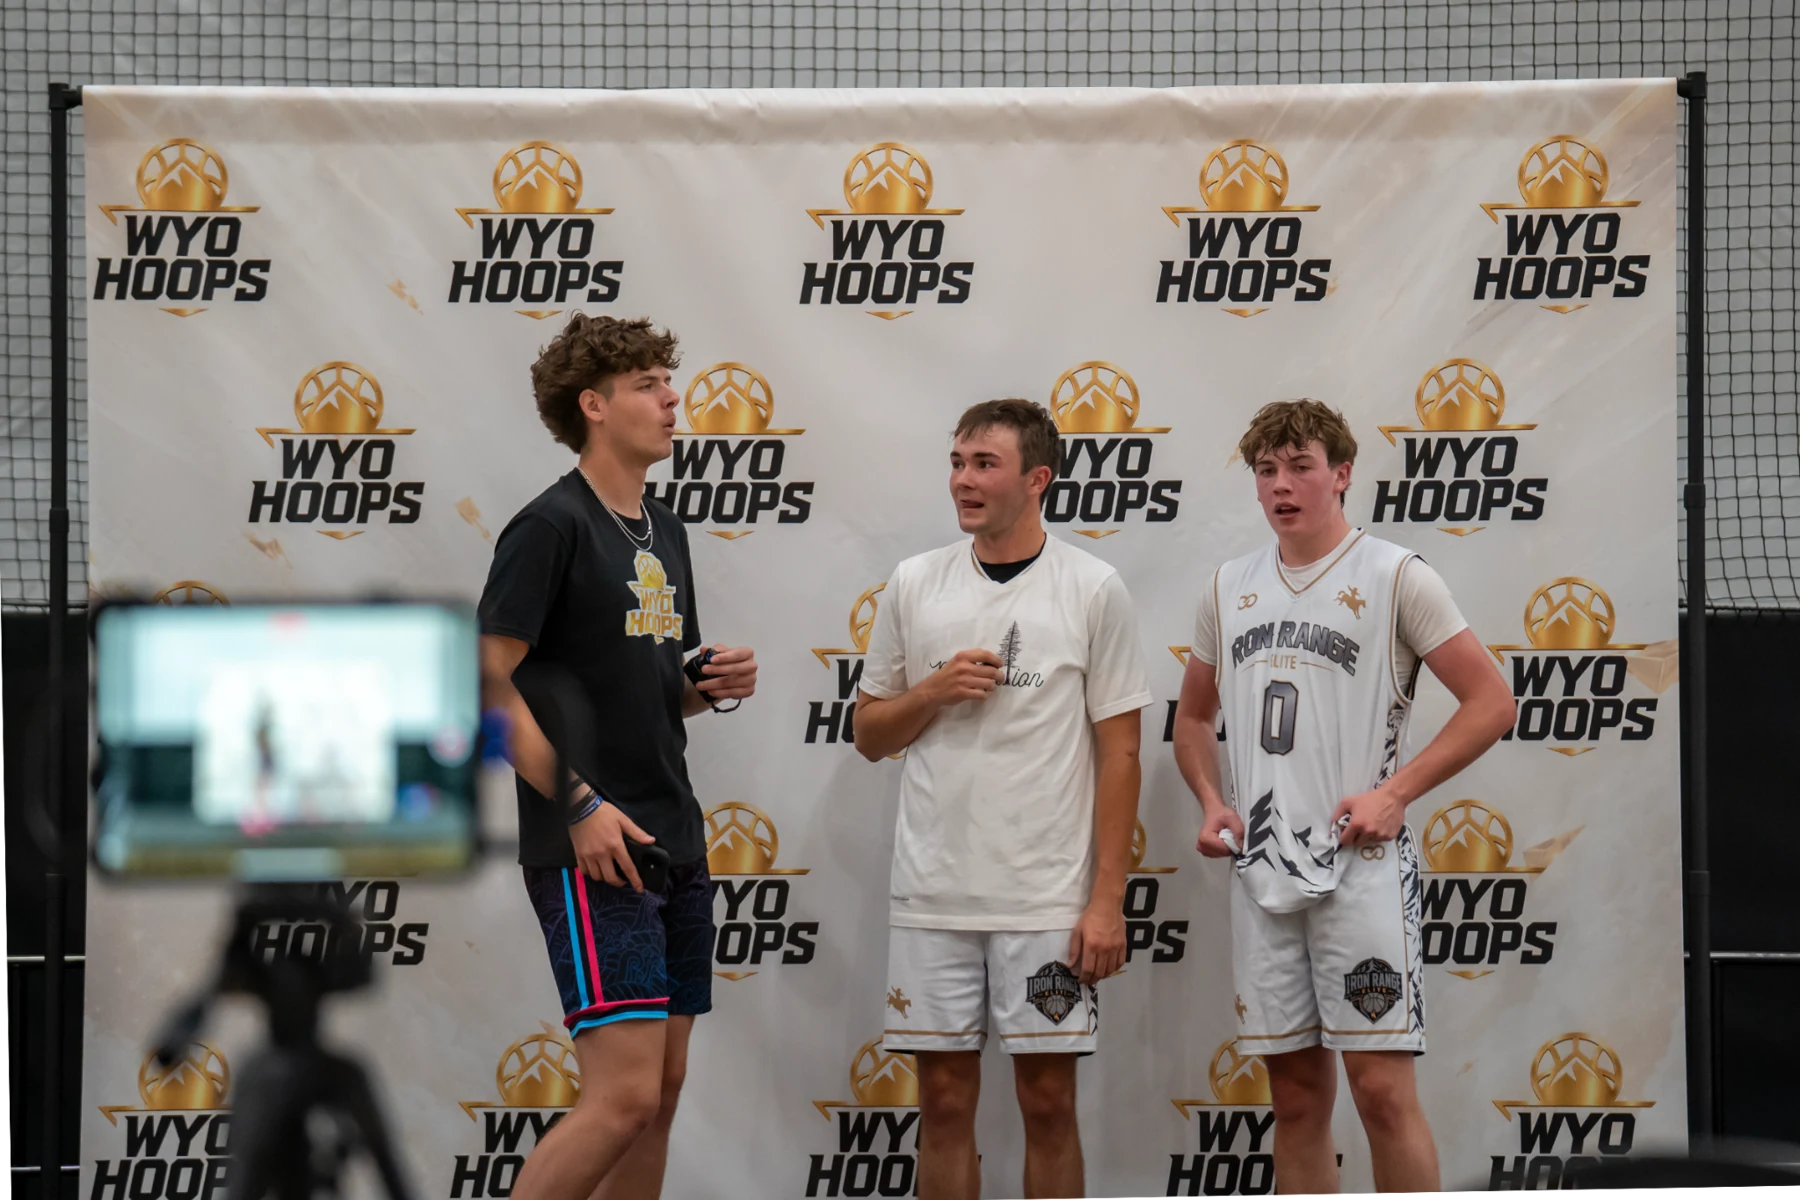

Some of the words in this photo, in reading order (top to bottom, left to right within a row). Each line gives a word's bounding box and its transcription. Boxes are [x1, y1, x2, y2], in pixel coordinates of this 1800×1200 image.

[126, 216, 241, 257] WYO
[481, 218, 594, 259] WYO
[831, 219, 945, 260] WYO
[1187, 217, 1302, 259] WYO
[1505, 213, 1621, 255] WYO
[93, 258, 271, 302] HOOPS
[448, 260, 624, 303] HOOPS
[799, 262, 974, 304] HOOPS
[1156, 259, 1332, 303] HOOPS
[1473, 255, 1651, 300] HOOPS
[281, 439, 395, 480] WYO
[672, 439, 786, 480] WYO
[1404, 436, 1519, 479] WYO
[248, 481, 425, 524] HOOPS
[1044, 480, 1183, 523] OOPS
[1372, 479, 1549, 523] HOOPS
[640, 588, 673, 615] WYO
[629, 611, 683, 639] HOOPS
[1231, 621, 1275, 671] RON
[1276, 620, 1361, 677] RANGE
[1270, 653, 1297, 670] LITE
[1511, 655, 1628, 697] WYO
[1261, 679, 1299, 756] 0
[710, 879, 790, 921] YO
[1420, 878, 1528, 921] WYO
[711, 921, 820, 965] OPS
[1421, 921, 1558, 965] OOPS
[1028, 975, 1053, 998] IRON
[1346, 972, 1370, 994] IRON
[1372, 972, 1401, 994] RANGE
[483, 1111, 569, 1154] WY
[837, 1111, 921, 1153] WY
[1197, 1110, 1275, 1153] WY
[1518, 1111, 1636, 1155] WYO
[90, 1157, 238, 1200] HOOP
[805, 1154, 919, 1198] HOO
[1166, 1153, 1278, 1198] HOO
